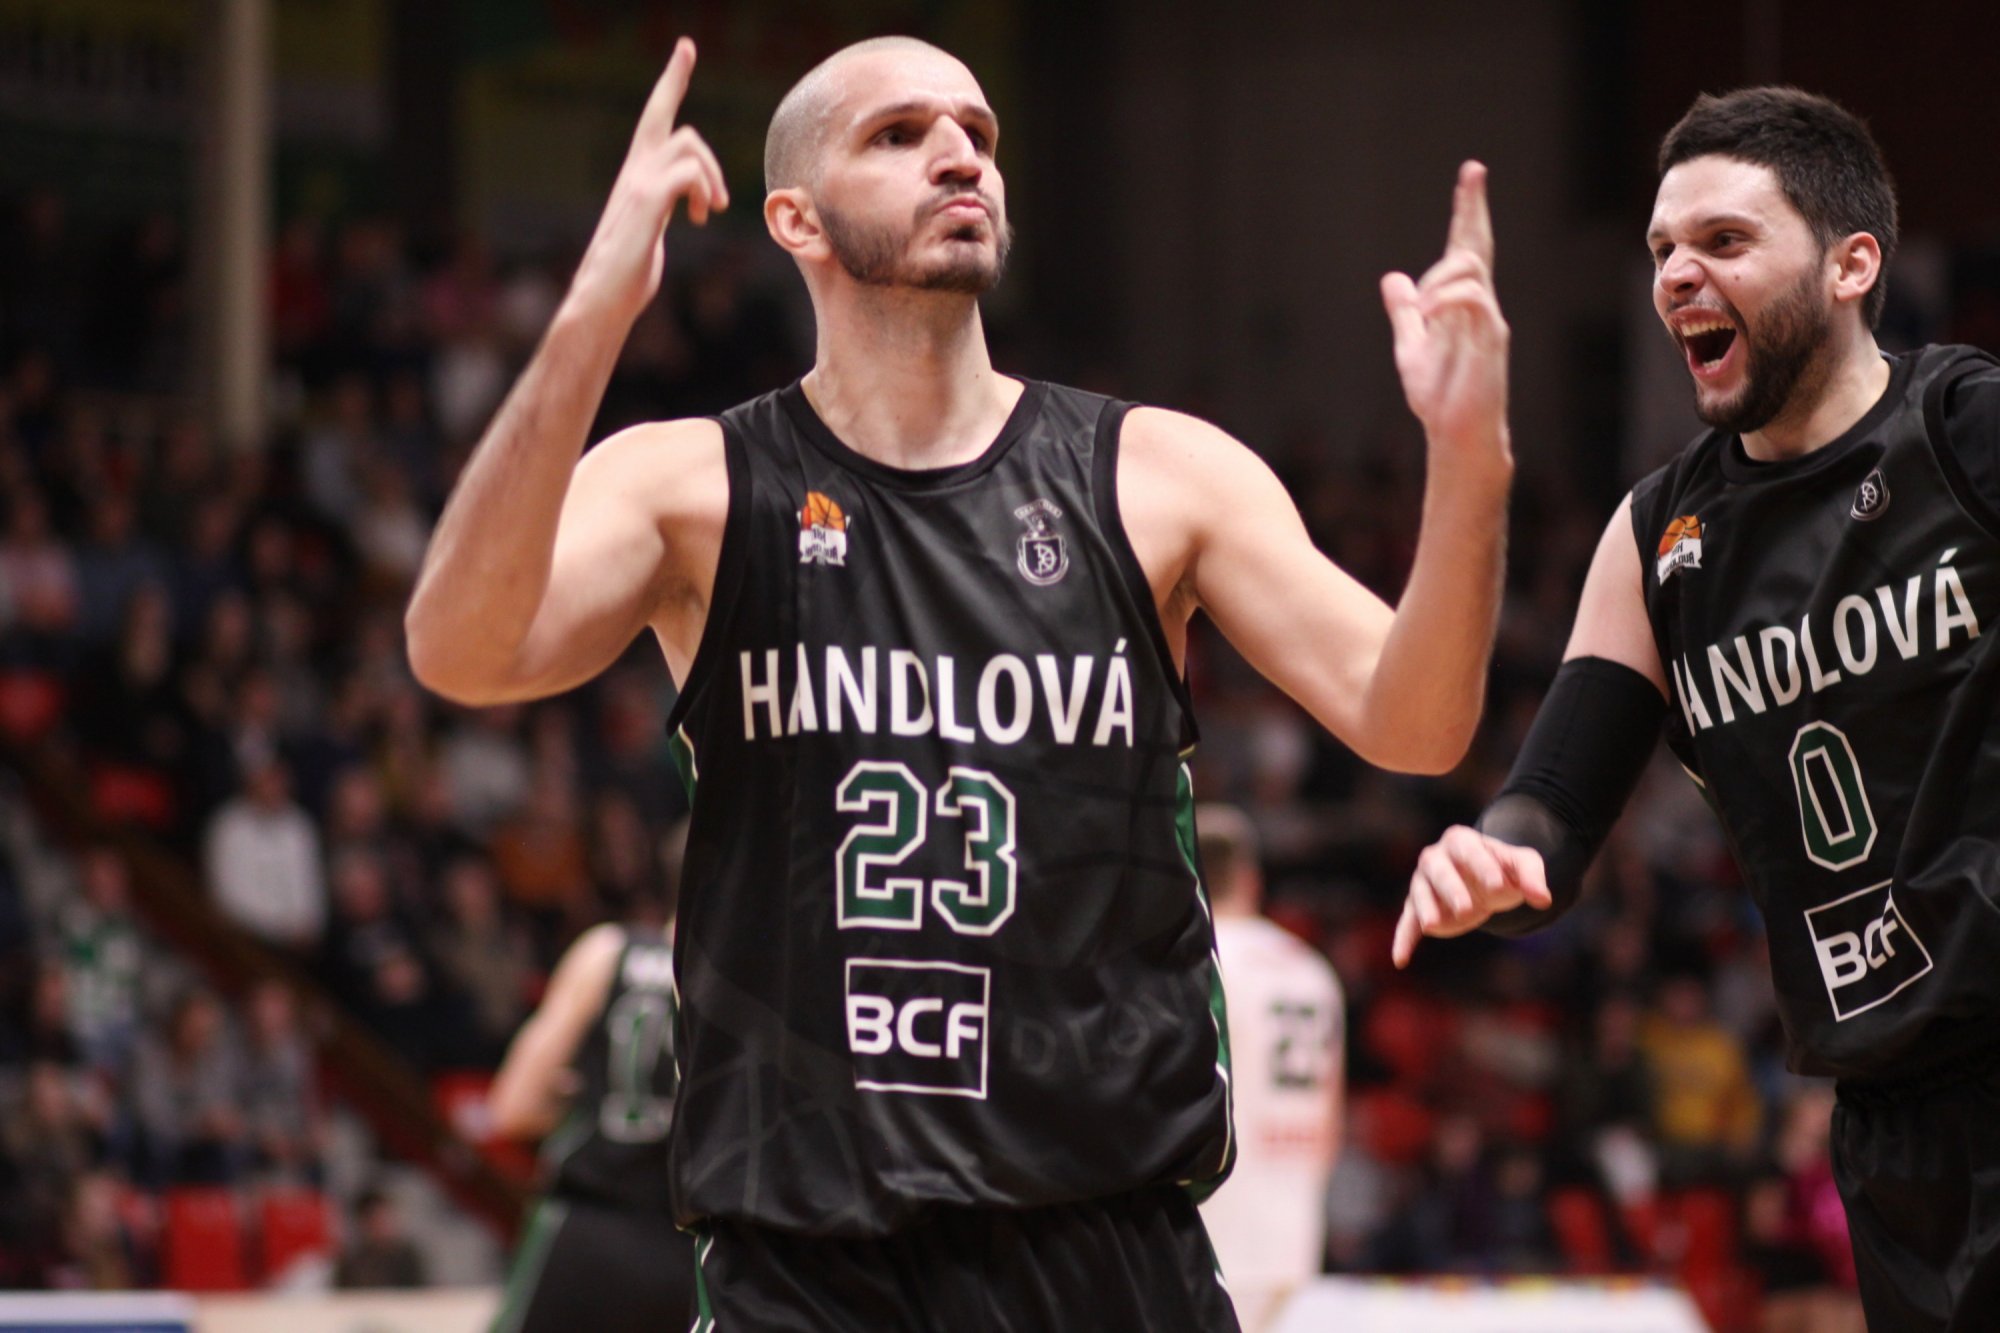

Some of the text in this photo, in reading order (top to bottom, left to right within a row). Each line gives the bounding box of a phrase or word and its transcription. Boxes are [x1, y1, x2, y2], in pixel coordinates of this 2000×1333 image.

[739, 637, 1134, 748] HANDLOVÁ
[836, 760, 1017, 936] 23
[1787, 720, 1878, 872] 0
[846, 994, 987, 1059] BCF
